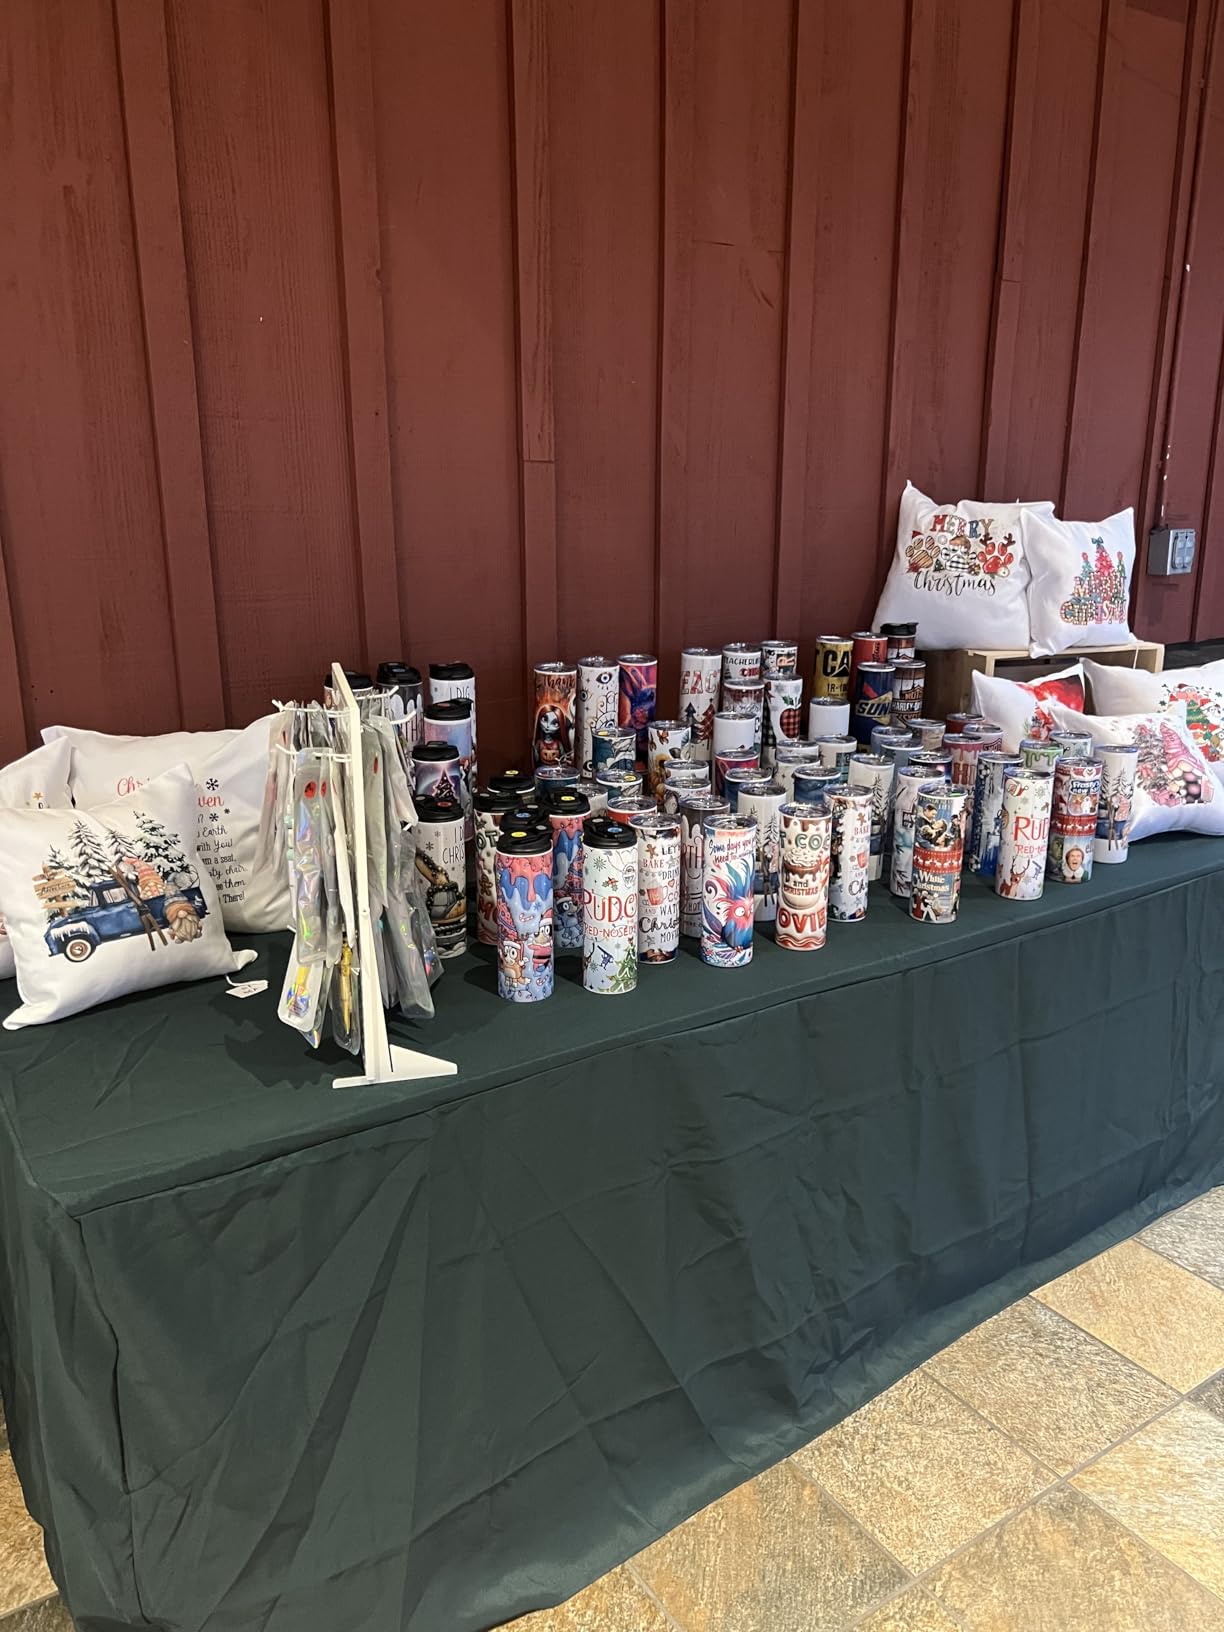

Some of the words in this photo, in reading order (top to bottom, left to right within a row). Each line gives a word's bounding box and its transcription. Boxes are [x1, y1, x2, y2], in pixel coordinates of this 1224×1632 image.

[930, 514, 994, 539] MERRY
[913, 570, 996, 597] Christmas
[642, 858, 665, 869] BAKE
[793, 880, 809, 888] and
